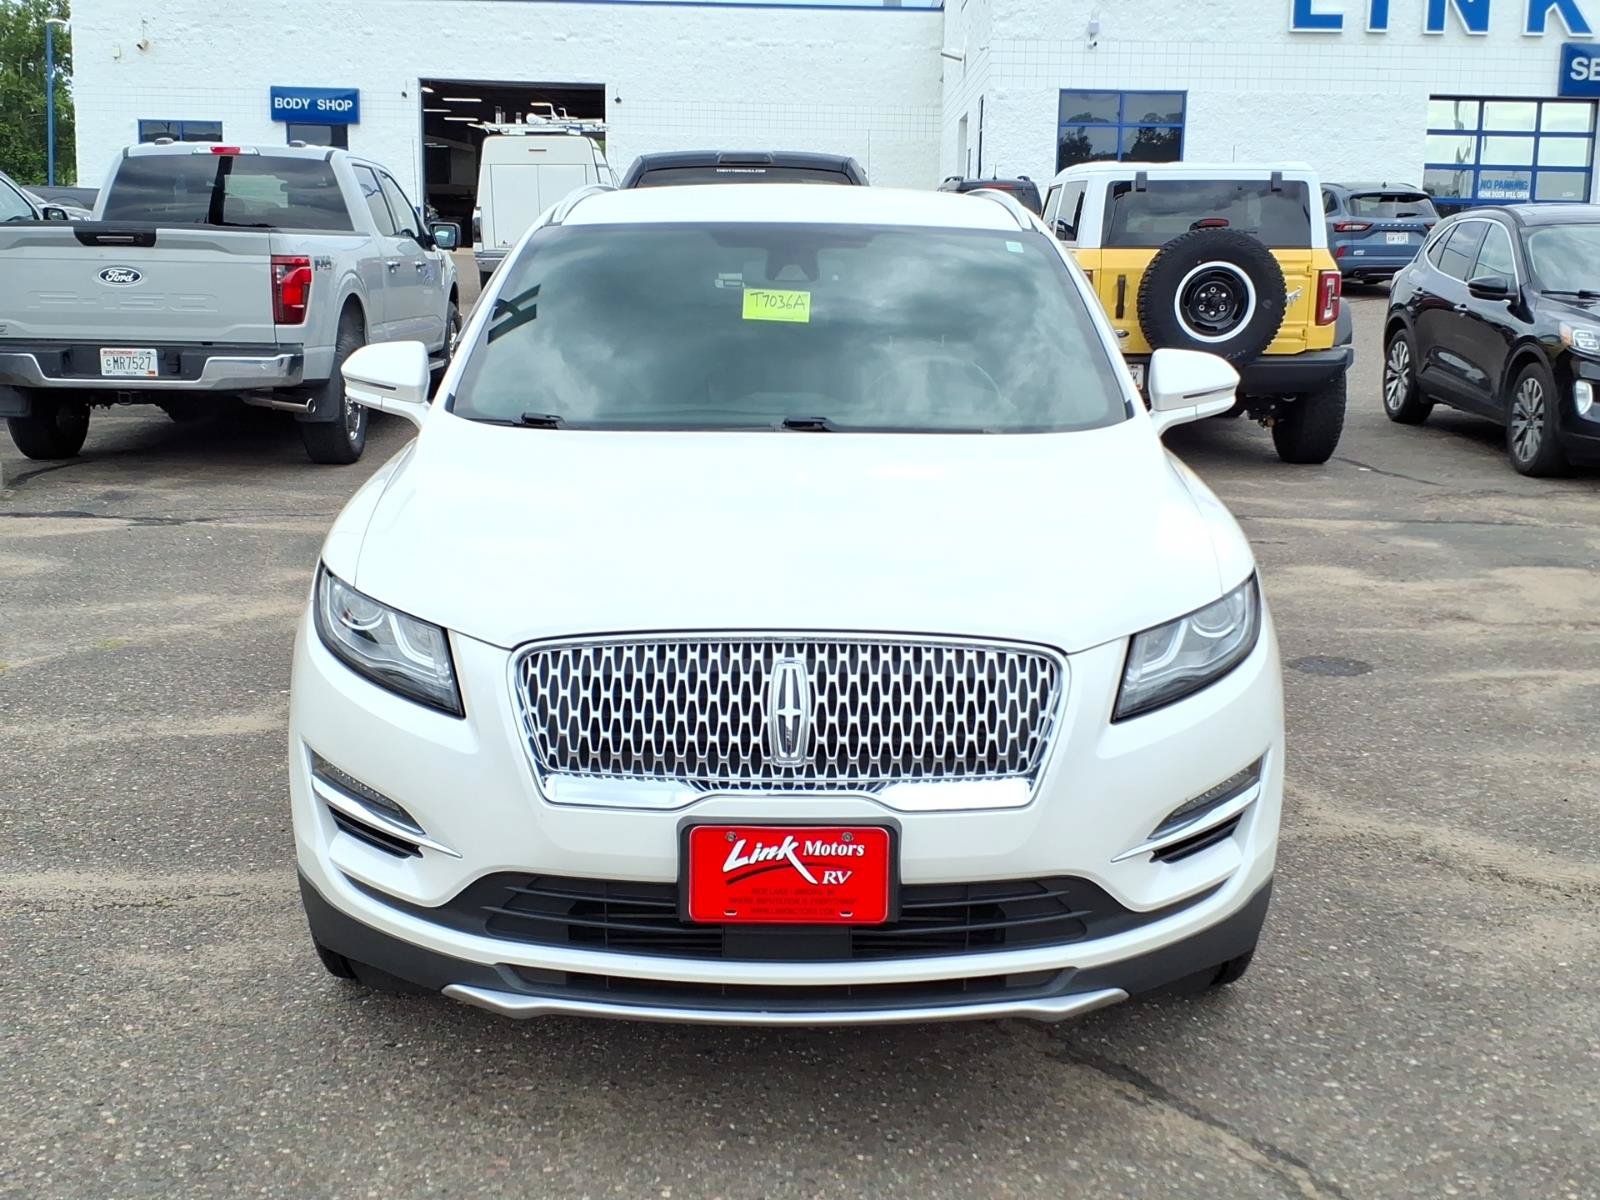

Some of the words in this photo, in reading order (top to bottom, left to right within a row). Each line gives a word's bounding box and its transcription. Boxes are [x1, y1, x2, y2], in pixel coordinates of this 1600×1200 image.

[274, 97, 310, 110] BODY
[317, 98, 353, 111] SHOP
[1480, 179, 1492, 189] NO
[1494, 179, 1528, 190] PARKING
[1517, 191, 1530, 199] OPEN
[106, 269, 134, 282] Ford
[749, 291, 806, 310] T7036A
[112, 356, 152, 370] MR7527
[722, 835, 819, 885] Link
[803, 840, 866, 857] Motors
[822, 870, 853, 885] RV
